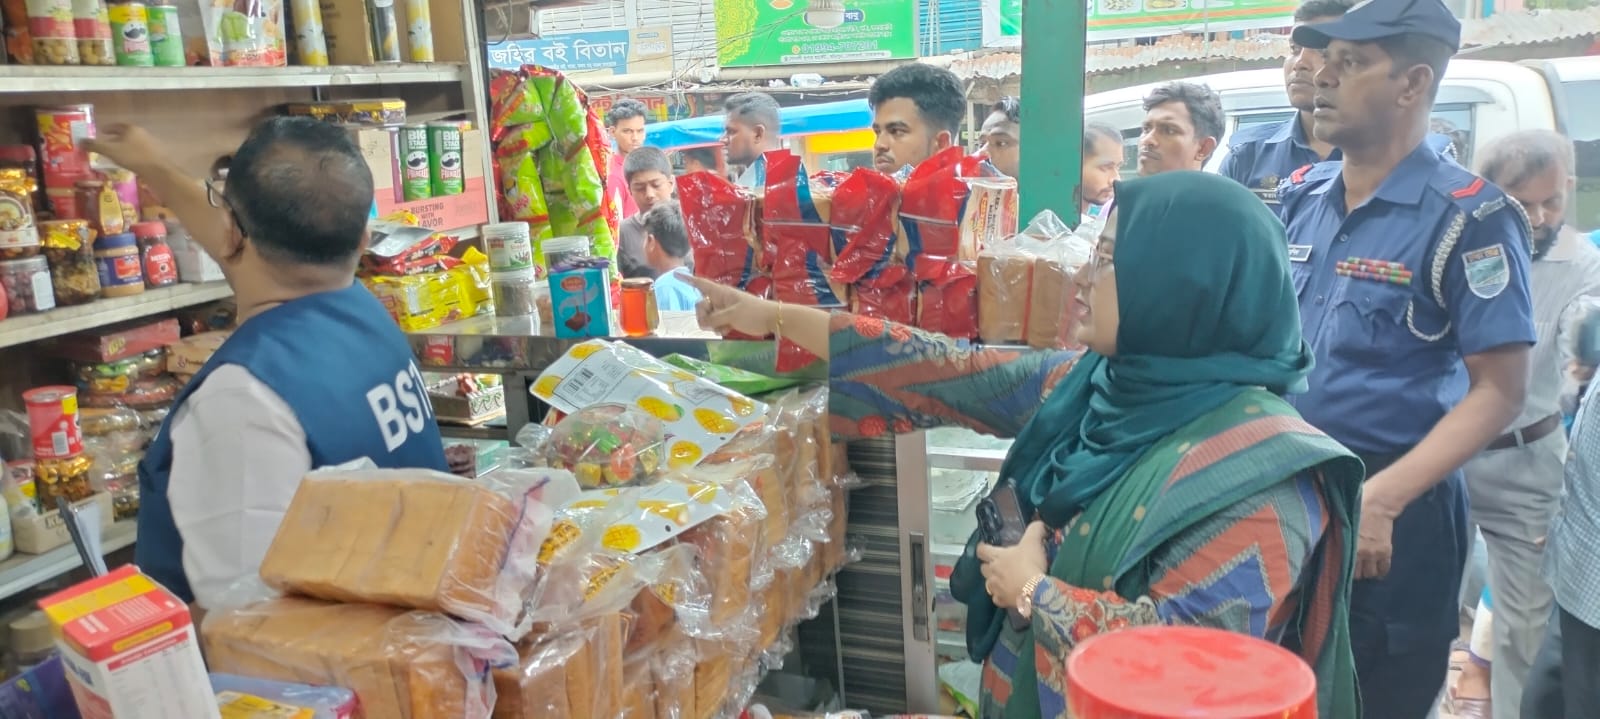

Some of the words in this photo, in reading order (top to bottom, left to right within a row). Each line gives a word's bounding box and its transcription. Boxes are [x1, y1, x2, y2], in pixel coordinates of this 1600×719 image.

[491, 43, 535, 65] জহির
[541, 38, 569, 63] বই
[573, 38, 627, 61] বিতান
[407, 129, 428, 140] BIG
[443, 130, 460, 141] BIG
[410, 202, 444, 213] BURSTING
